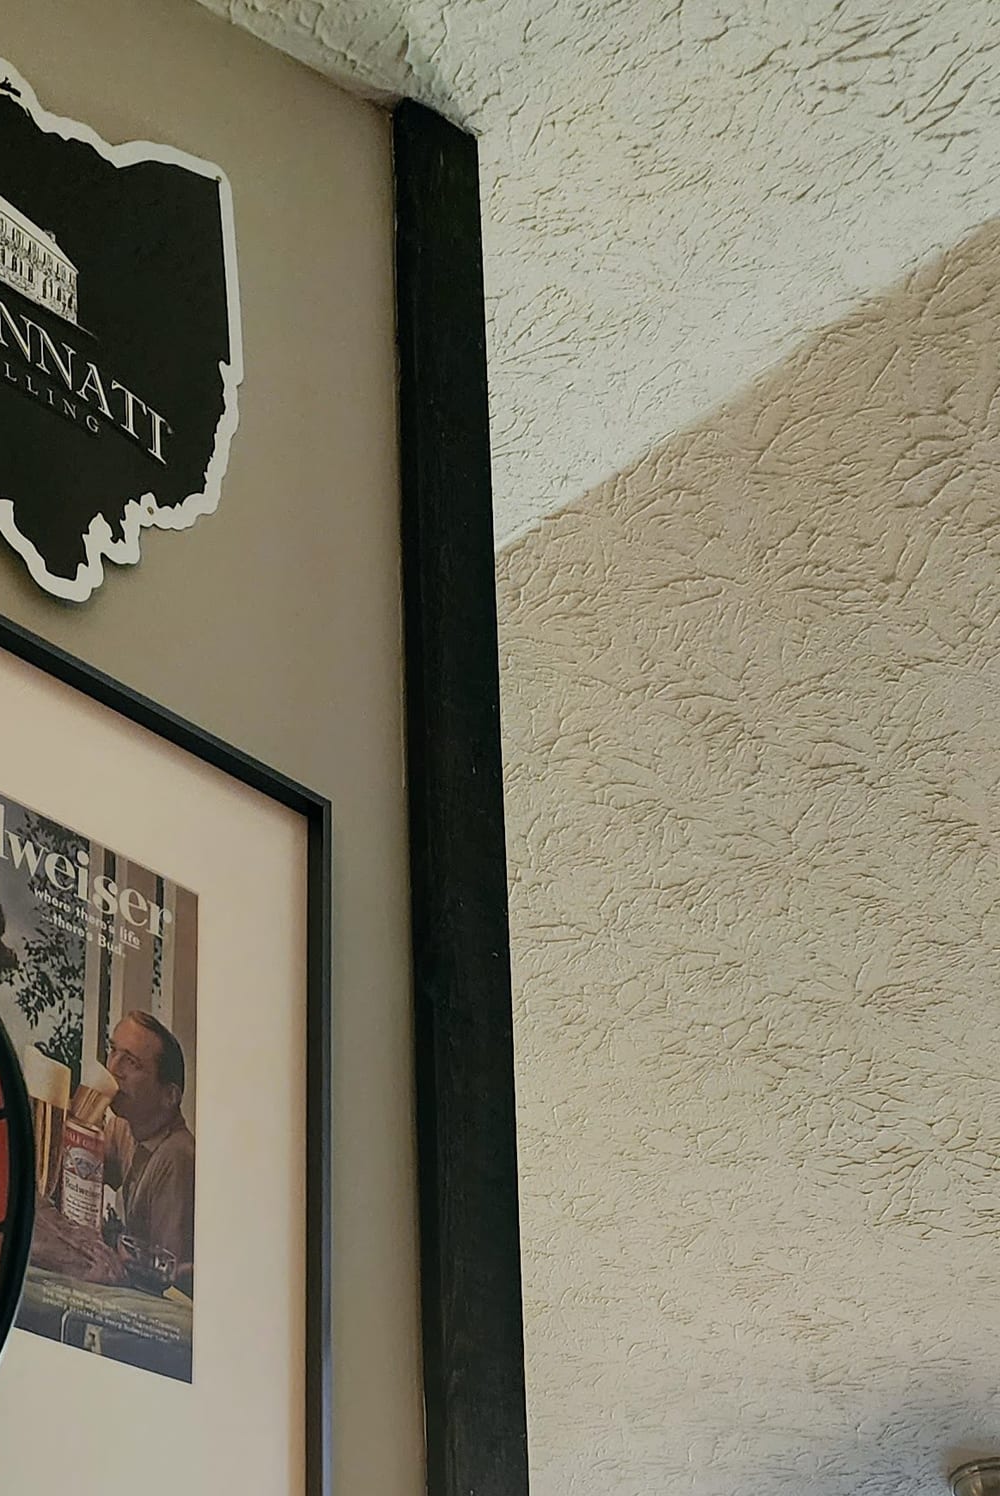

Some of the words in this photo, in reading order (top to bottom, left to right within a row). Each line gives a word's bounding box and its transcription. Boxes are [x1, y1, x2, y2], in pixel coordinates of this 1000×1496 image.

[33, 886, 71, 913] where
[75, 906, 115, 934] there's
[120, 926, 140, 948] life
